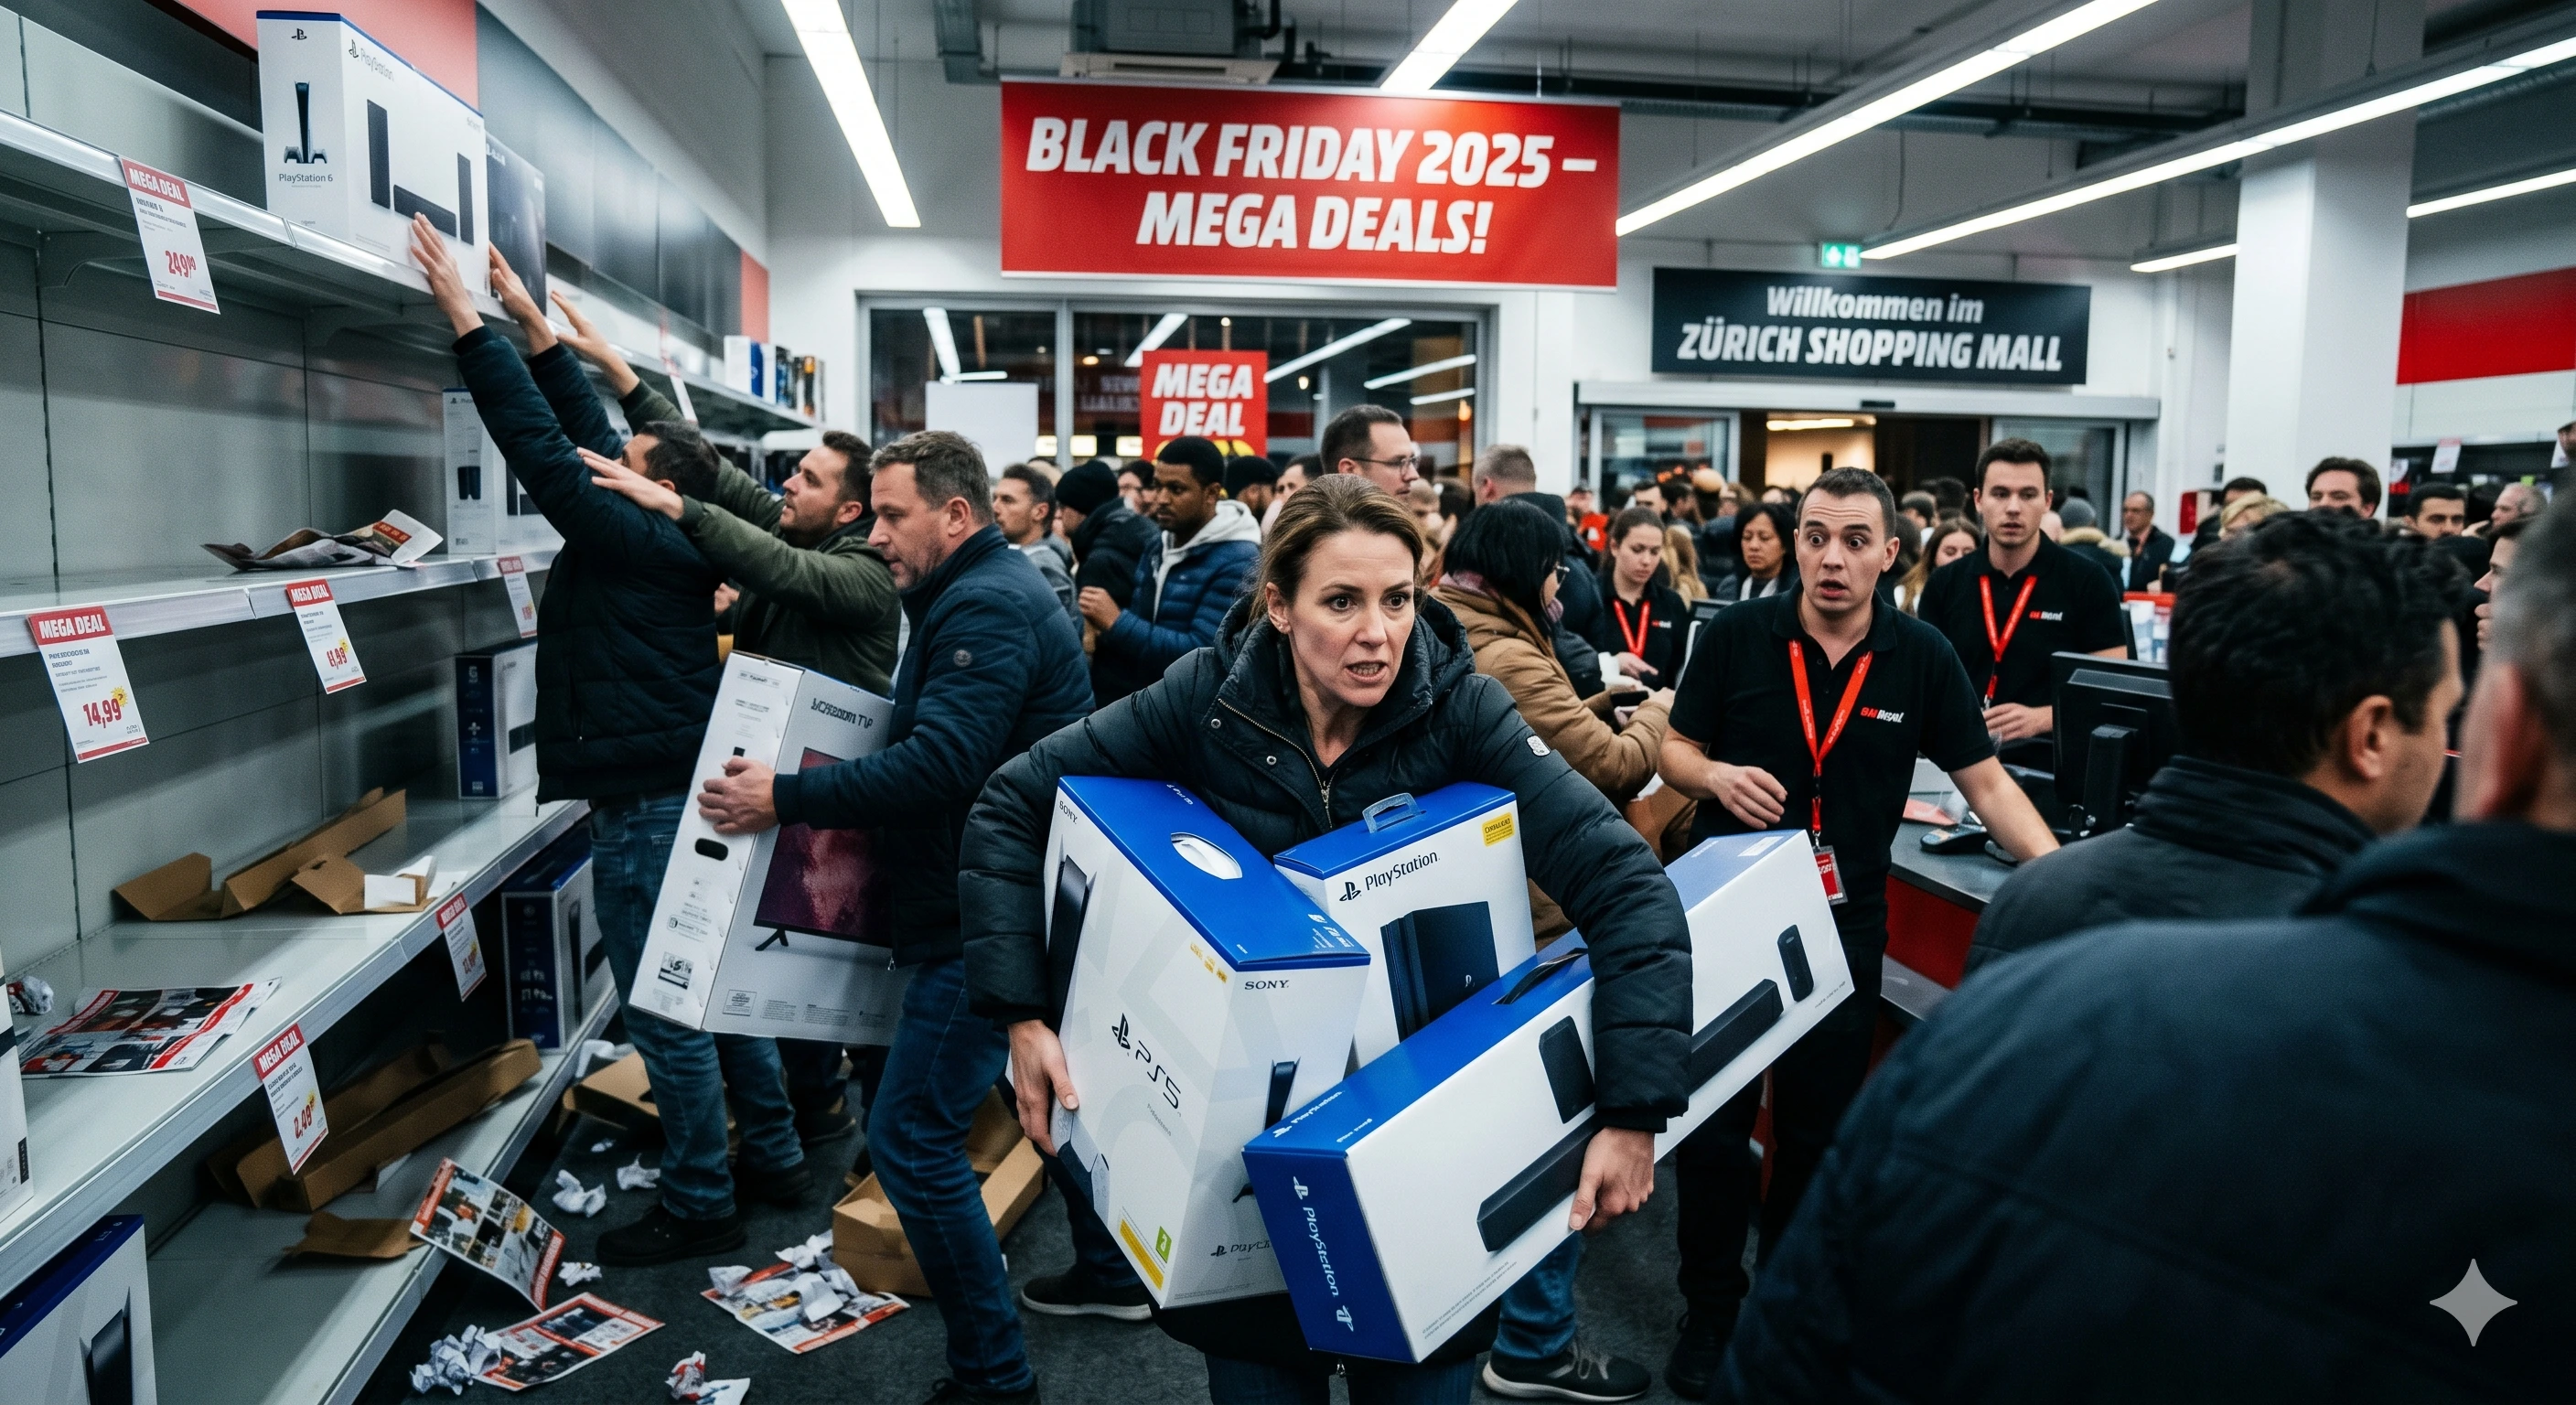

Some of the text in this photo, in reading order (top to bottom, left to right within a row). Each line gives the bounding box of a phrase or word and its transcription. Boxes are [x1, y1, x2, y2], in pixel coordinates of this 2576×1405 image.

[1025, 116, 1208, 176] BLACK
[1212, 123, 1415, 183] FRIDAY
[1415, 129, 1556, 188] 2025
[128, 167, 186, 202] MEGA DEAL
[278, 173, 334, 184] PlayStation 6
[1135, 190, 1495, 254] MEGA DEALS!
[1766, 284, 1984, 324] Willkommen im
[1676, 316, 2063, 372] ZÜRICH SHOPPING MALL
[1151, 363, 1254, 400] MEGA
[1158, 401, 1246, 436] DEAL
[38, 614, 106, 639] MEGA DEAL
[82, 698, 123, 729] 14,99
[1058, 800, 1079, 823] SONY
[1364, 851, 1439, 891] PlayStation
[1244, 980, 1289, 991] SONY
[1135, 1040, 1181, 1110] PS5
